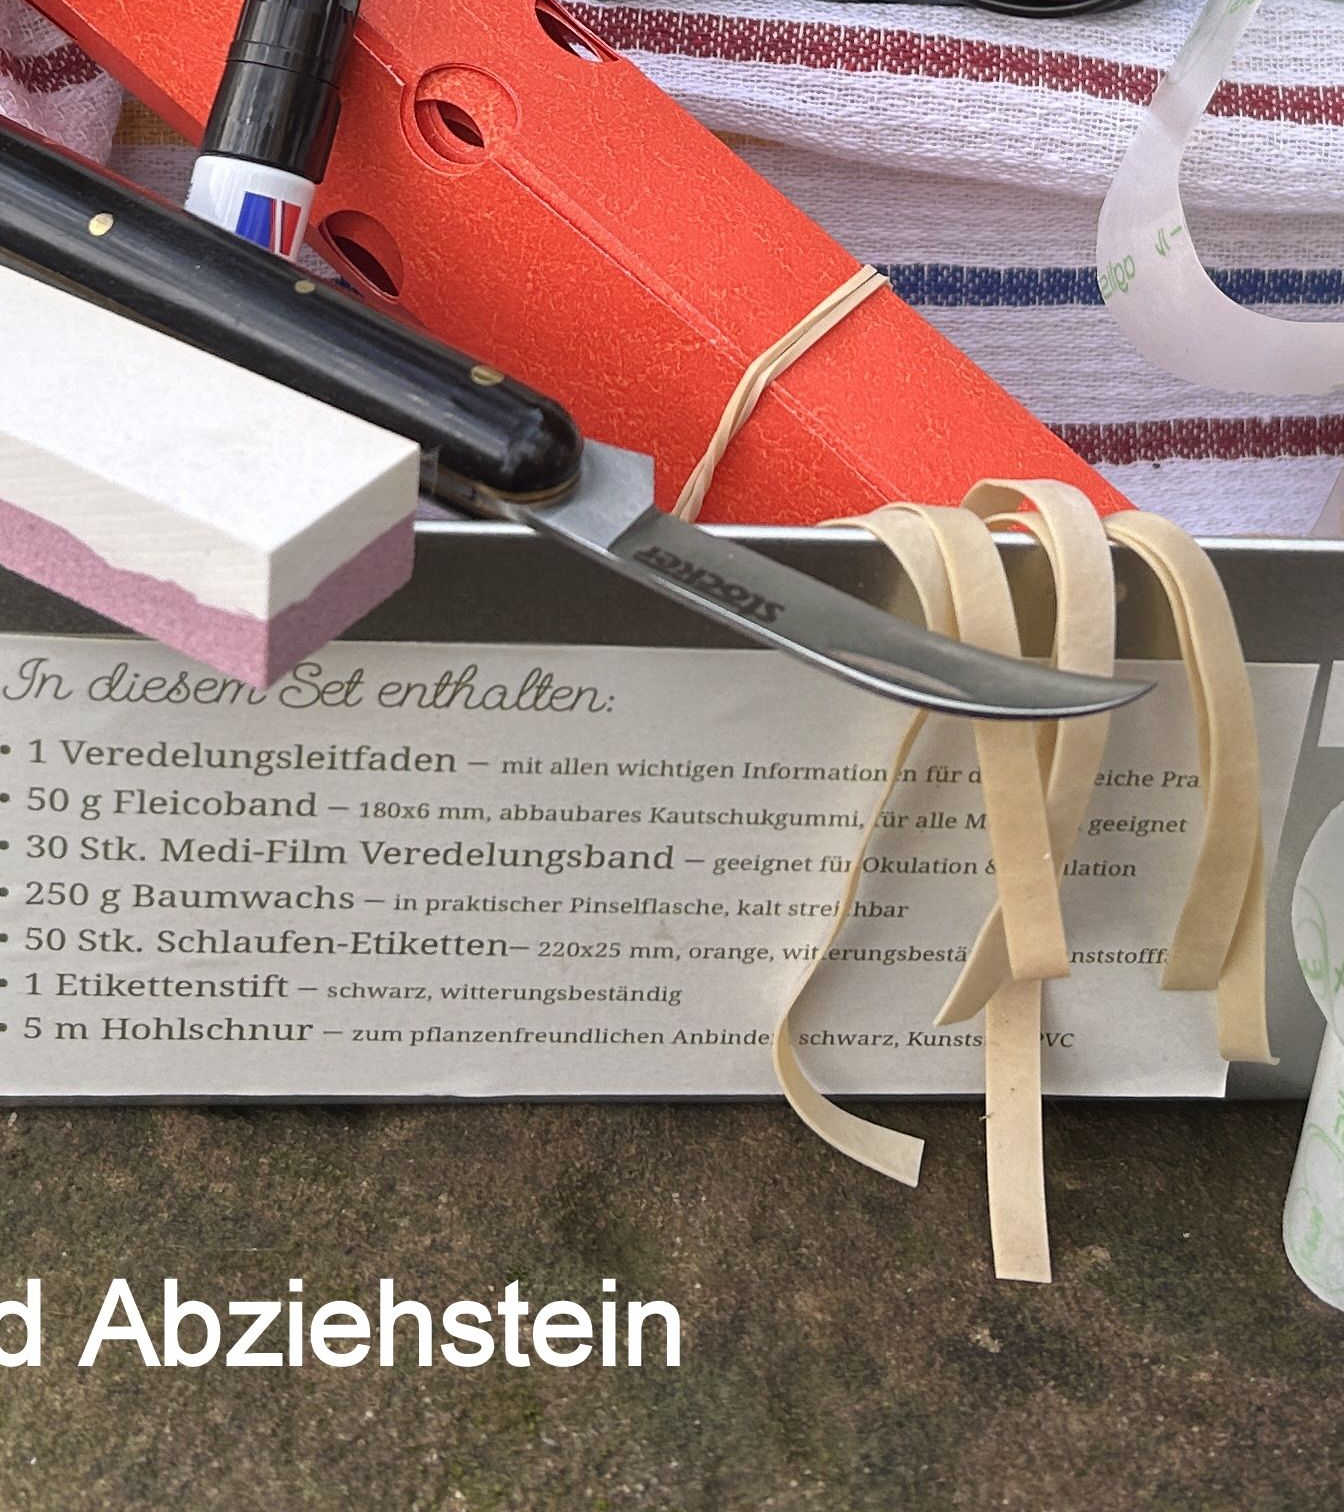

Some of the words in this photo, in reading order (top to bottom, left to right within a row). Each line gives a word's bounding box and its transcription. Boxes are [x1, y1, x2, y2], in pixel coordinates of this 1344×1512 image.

[3, 657, 71, 700] In
[88, 661, 269, 707] diesem
[279, 661, 363, 708] Set
[378, 663, 614, 713] enthalten:
[29, 740, 47, 765] 1
[60, 740, 456, 776] Veredelungsleitfaden
[501, 757, 543, 775] mit
[549, 758, 609, 776] allen
[617, 760, 736, 783] wichtigen
[742, 762, 918, 784] Informationn
[926, 764, 966, 784] für
[27, 787, 70, 814] 50
[81, 795, 102, 821] g
[113, 789, 318, 818] Fleicoband
[359, 802, 431, 821] 180x6
[438, 806, 493, 824] mm,
[499, 804, 642, 825] abbaubares
[650, 807, 866, 831] Kautschukgummi,
[914, 810, 959, 830] alle
[1088, 815, 1188, 838] geeignet
[27, 835, 69, 862] 30
[80, 836, 147, 863] Stk.
[160, 837, 346, 865] Medi-Film
[361, 840, 674, 875] Veredelungsband
[713, 854, 812, 877] geeignet
[862, 854, 979, 876] Okulation
[25, 882, 89, 908] 250
[100, 889, 121, 913] g
[132, 883, 355, 910] Baumwachs
[393, 894, 417, 912] in
[425, 894, 563, 918] praktischer
[569, 896, 729, 919] Pinselflasche,
[737, 896, 782, 917] kalt
[787, 899, 910, 919] streihbar
[24, 927, 66, 953] 50
[77, 928, 144, 954] Stk.
[538, 942, 621, 959] 220x25
[630, 944, 681, 962] mm,
[689, 946, 775, 965] orange,
[25, 974, 41, 997] 1
[56, 974, 289, 998] Etikettenstift
[327, 982, 433, 1001] schwarz,
[440, 982, 682, 1006] witterungsbeständig
[24, 1017, 41, 1040] 5
[55, 1022, 88, 1040] m
[102, 1017, 314, 1042] Hohlschnur
[352, 1028, 404, 1043] zum
[409, 1025, 665, 1046] pflanzenfreundlichen
[799, 1030, 899, 1048] schwarz,
